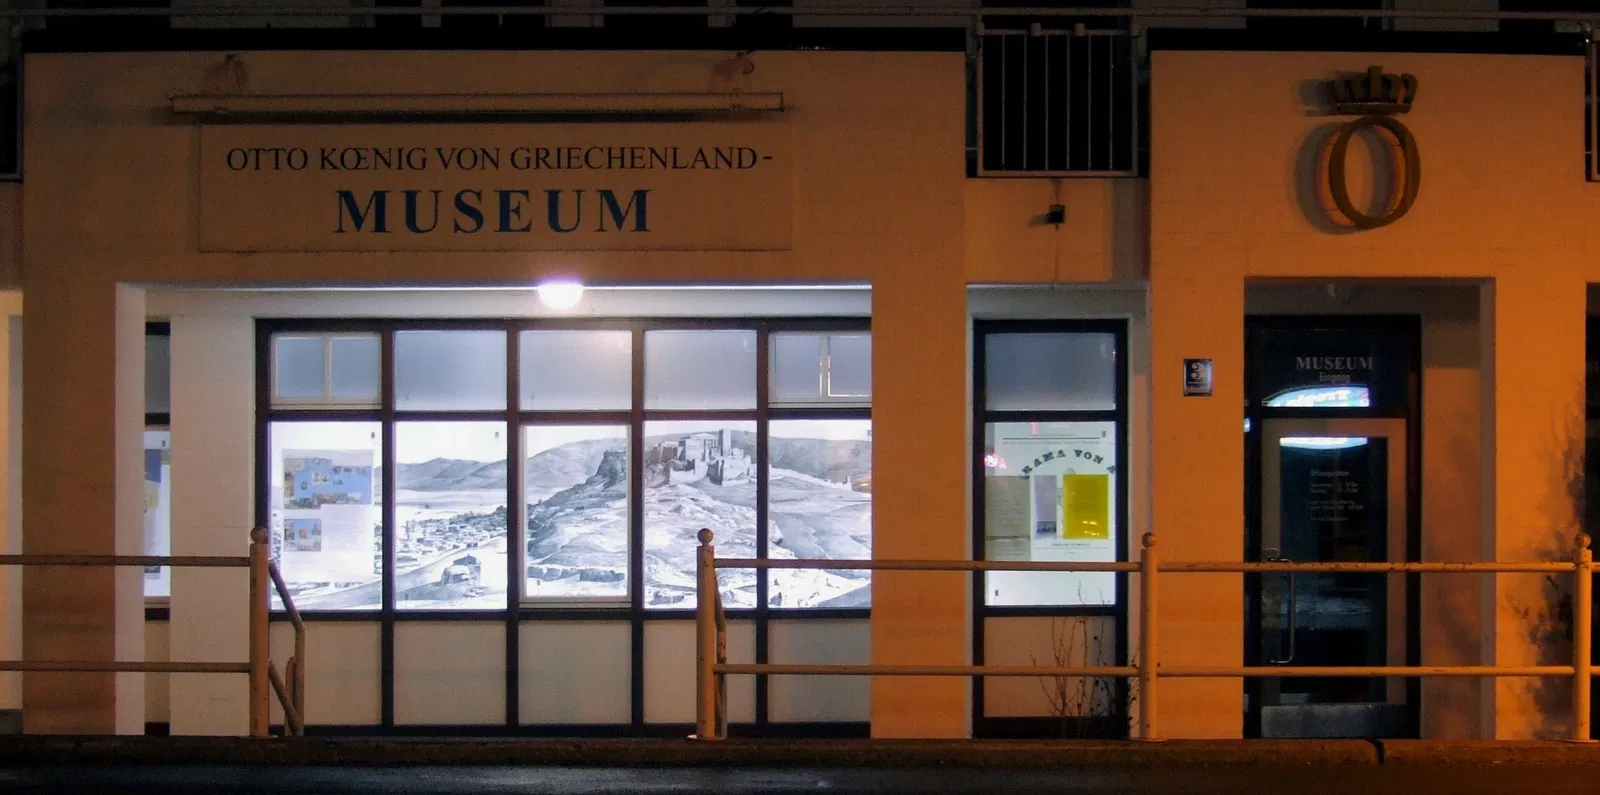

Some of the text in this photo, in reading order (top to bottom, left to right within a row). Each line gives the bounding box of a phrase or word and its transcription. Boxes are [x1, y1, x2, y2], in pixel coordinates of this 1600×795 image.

[226, 147, 774, 172] OTTO KŒNIG VON GRIECHENLAND-
[335, 188, 652, 235] MUSEUM
[1191, 362, 1205, 380] 3
[1295, 357, 1374, 371] MUSEUM
[1074, 449, 1104, 465] VON
